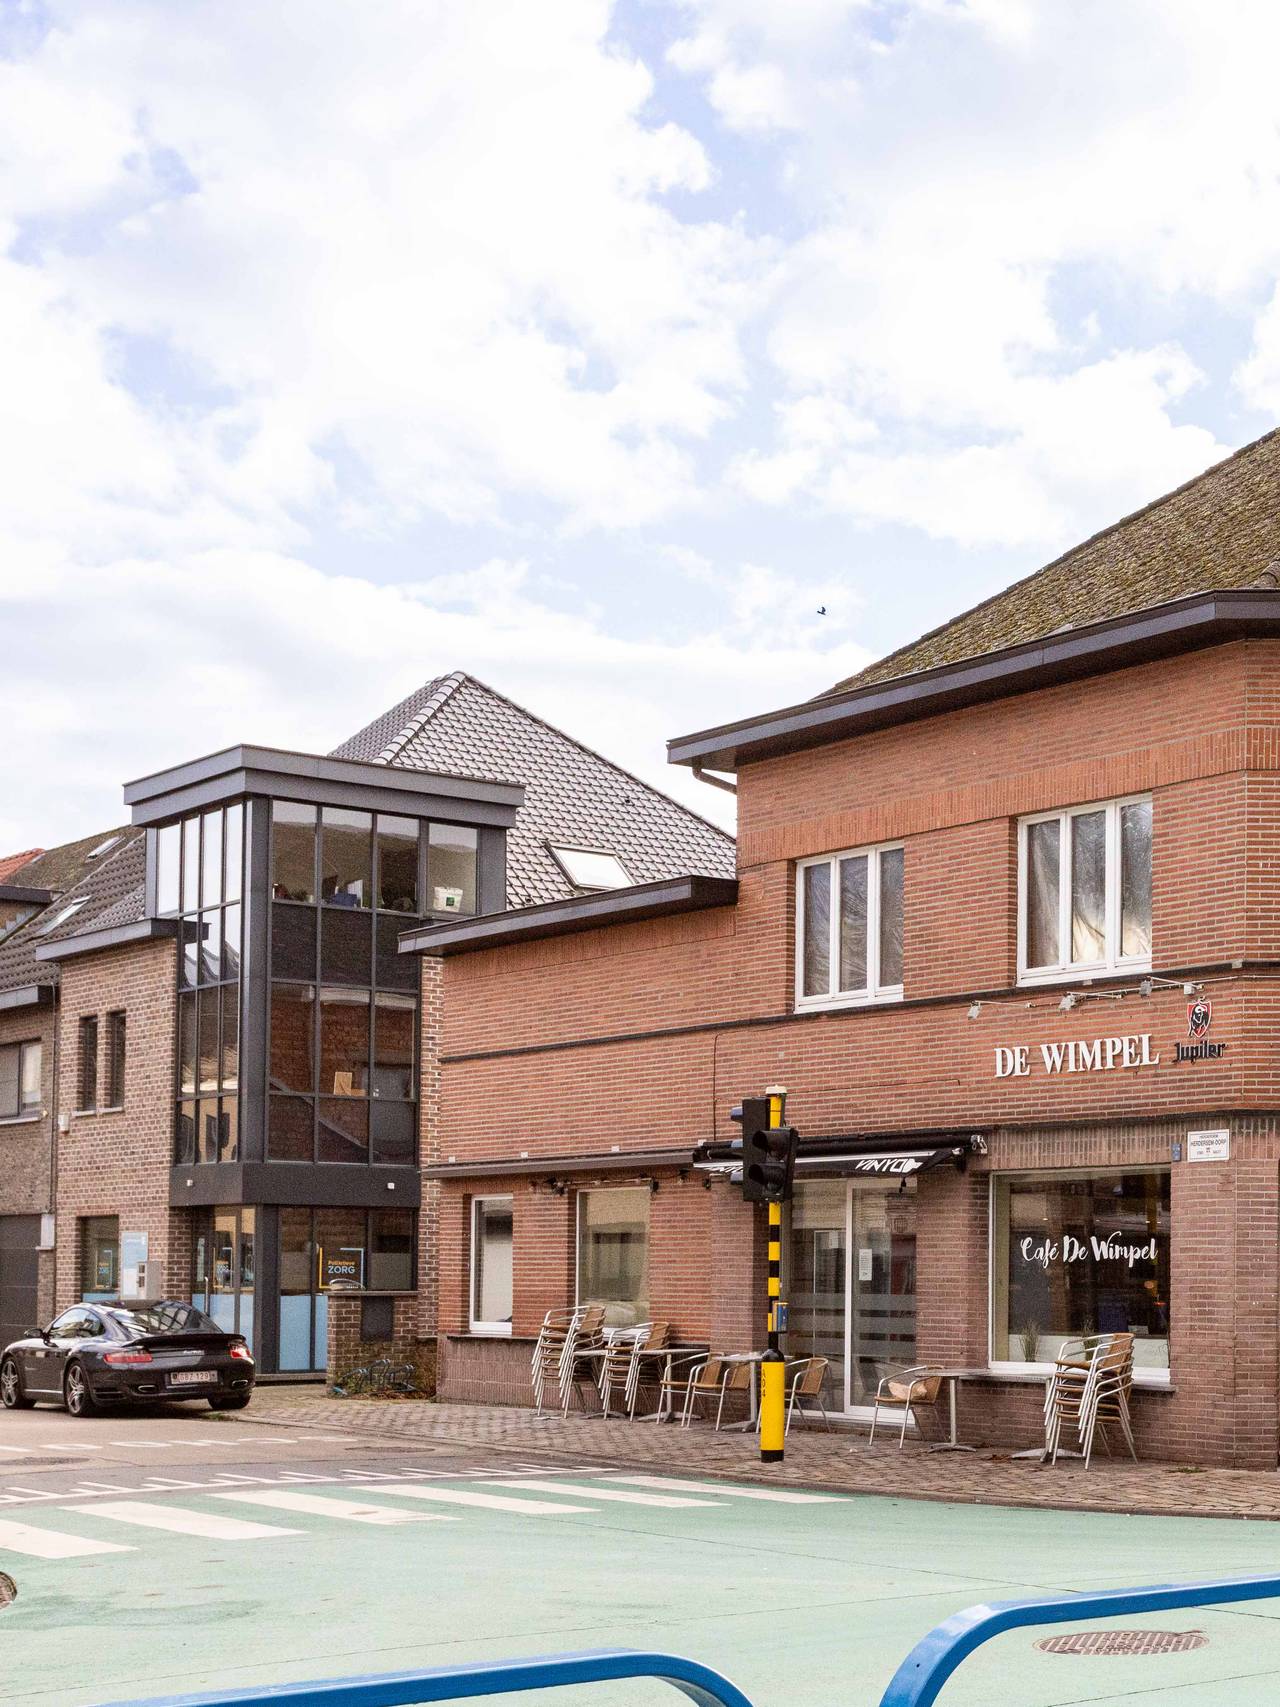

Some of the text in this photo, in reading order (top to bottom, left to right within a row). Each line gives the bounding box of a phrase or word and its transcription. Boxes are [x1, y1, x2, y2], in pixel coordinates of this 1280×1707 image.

[994, 1033, 1161, 1078] DE WIMPEL
[1172, 1039, 1229, 1064] Jupiler
[1020, 1230, 1159, 1269] Café De Wimpel
[328, 1266, 356, 1274] ZORG
